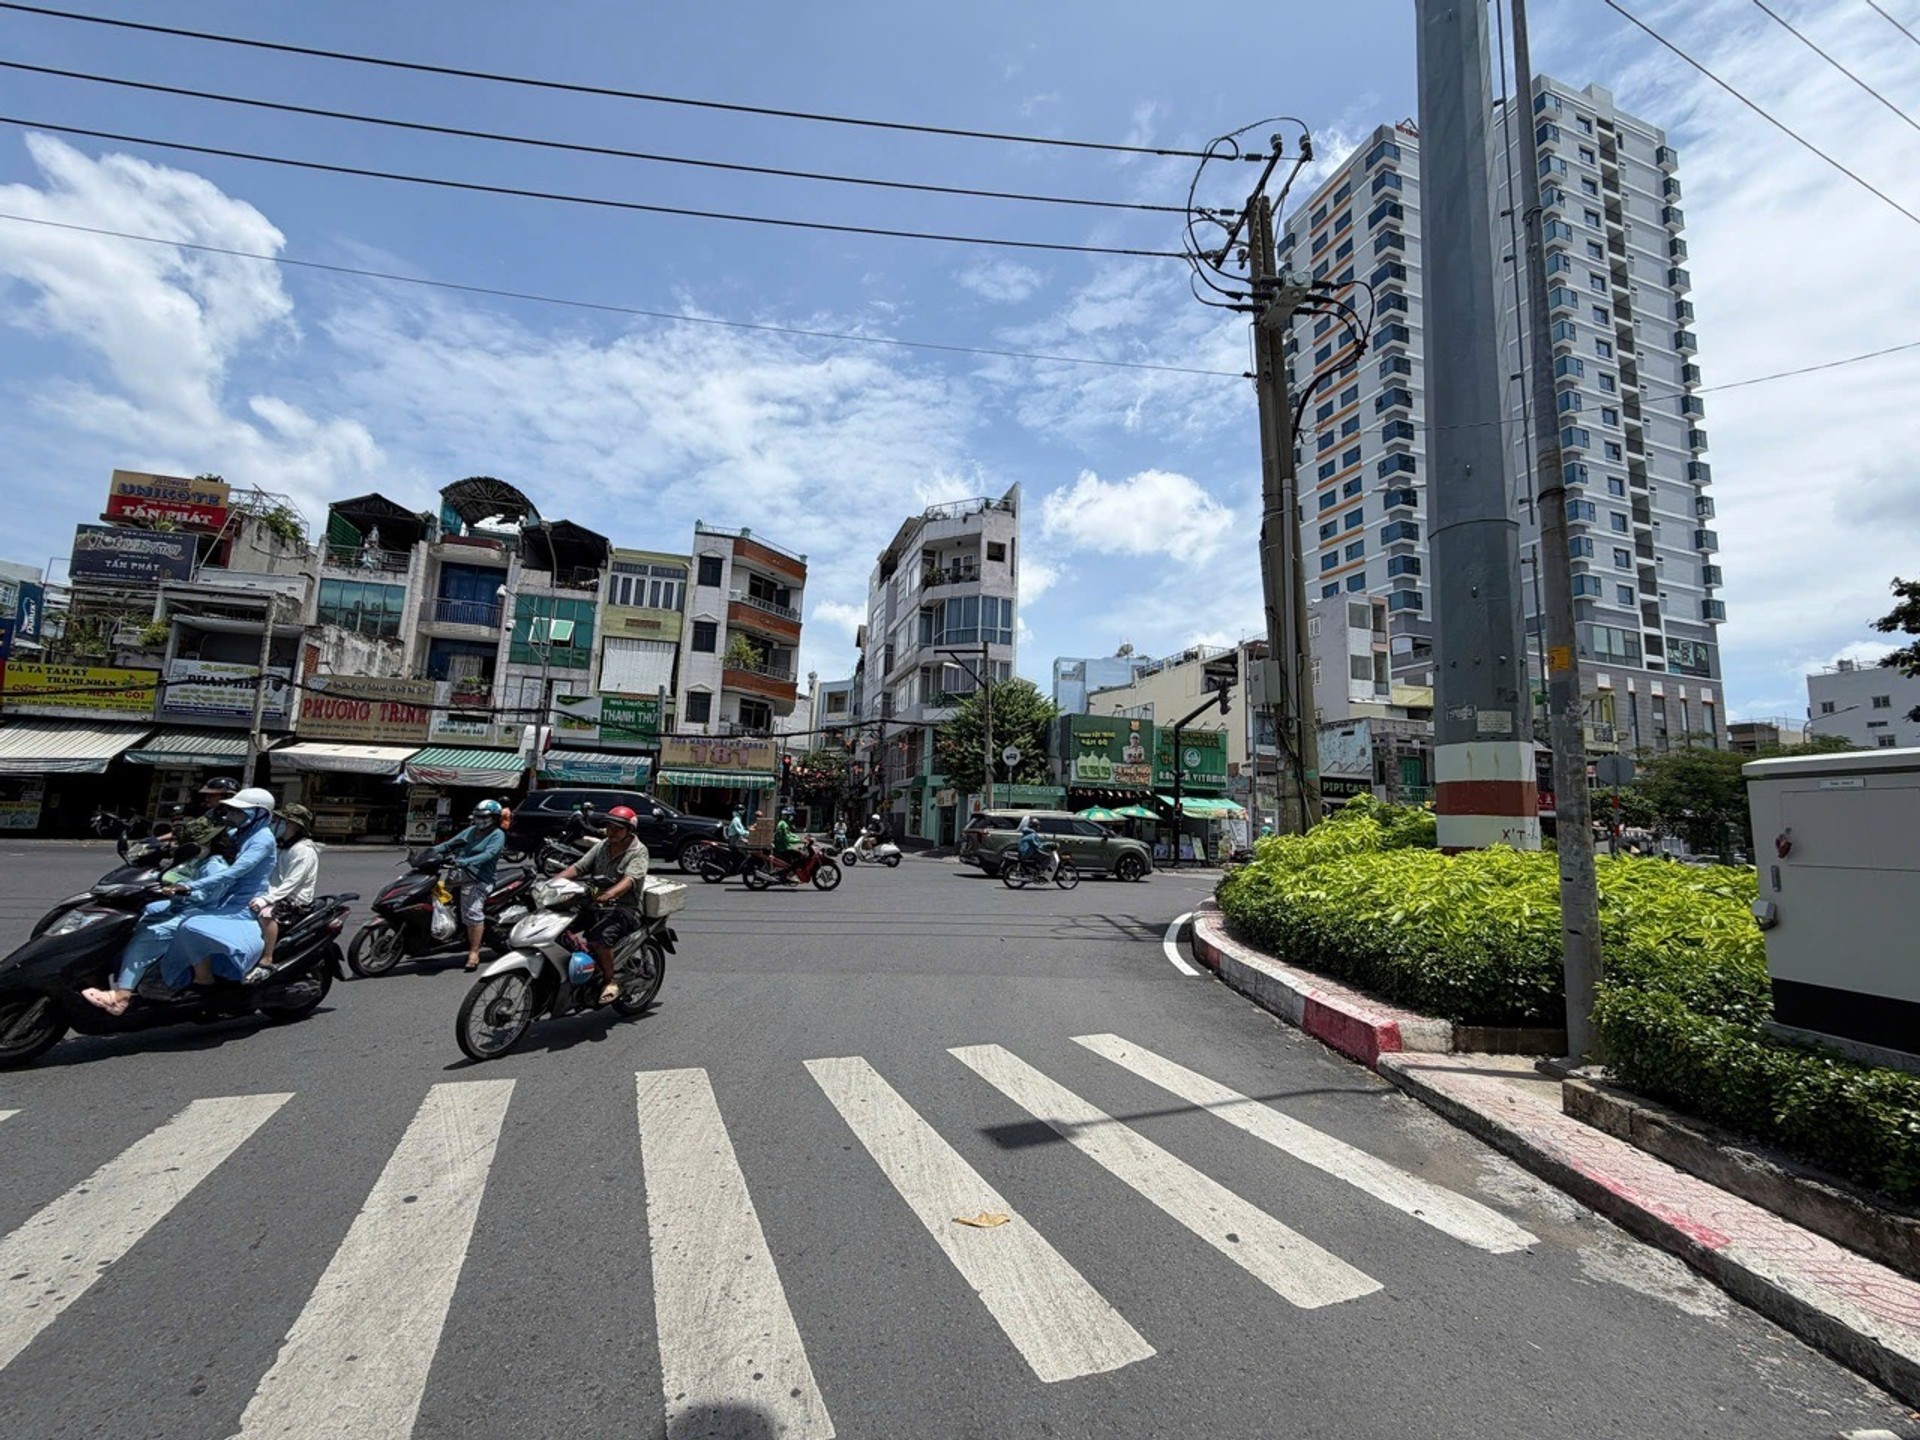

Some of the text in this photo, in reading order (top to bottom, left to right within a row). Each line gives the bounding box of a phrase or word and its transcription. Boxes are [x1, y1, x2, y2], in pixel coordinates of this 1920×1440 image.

[117, 482, 221, 505] UNIKOTE
[163, 509, 213, 524] PHÁT
[27, 666, 42, 674] TA
[45, 666, 71, 676] TAM
[603, 709, 635, 722] THANH
[690, 745, 749, 766] 181
[1322, 782, 1345, 792] PIPI
